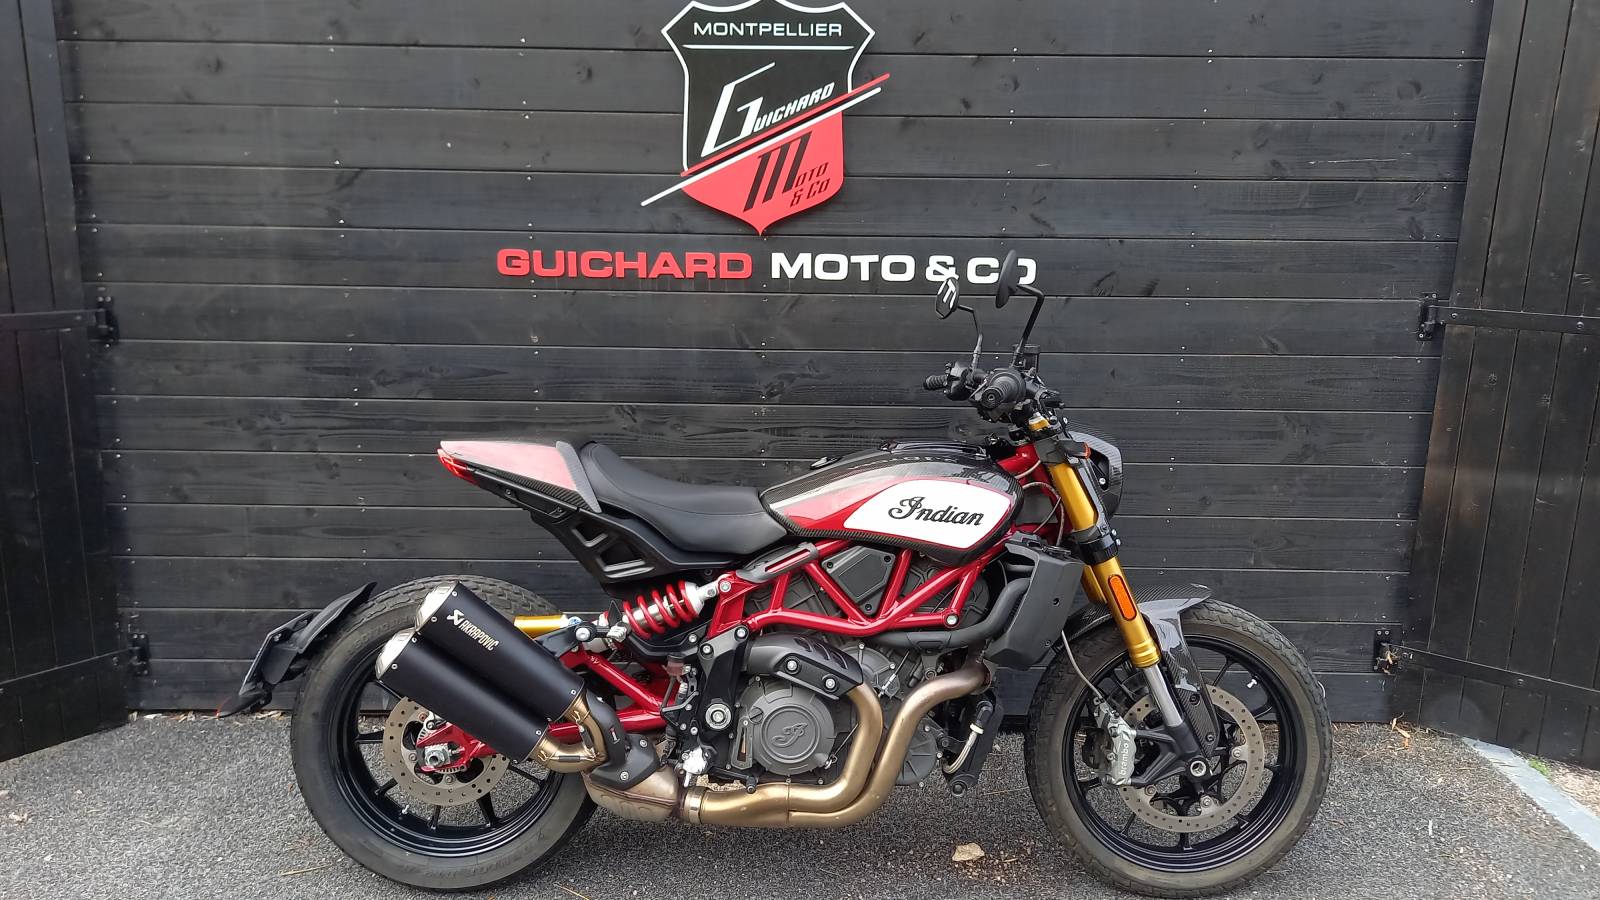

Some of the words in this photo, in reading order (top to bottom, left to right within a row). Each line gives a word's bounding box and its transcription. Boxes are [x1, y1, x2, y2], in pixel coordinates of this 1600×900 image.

[693, 22, 843, 37] MONTPELLIER
[700, 62, 835, 158] GUICHARD
[496, 248, 753, 280] GUICHARD
[771, 252, 916, 282] MOTO
[925, 255, 959, 282] &
[887, 496, 984, 526] Indian
[458, 619, 500, 651] AKRAPOVIC
[1118, 742, 1129, 776] brembo
